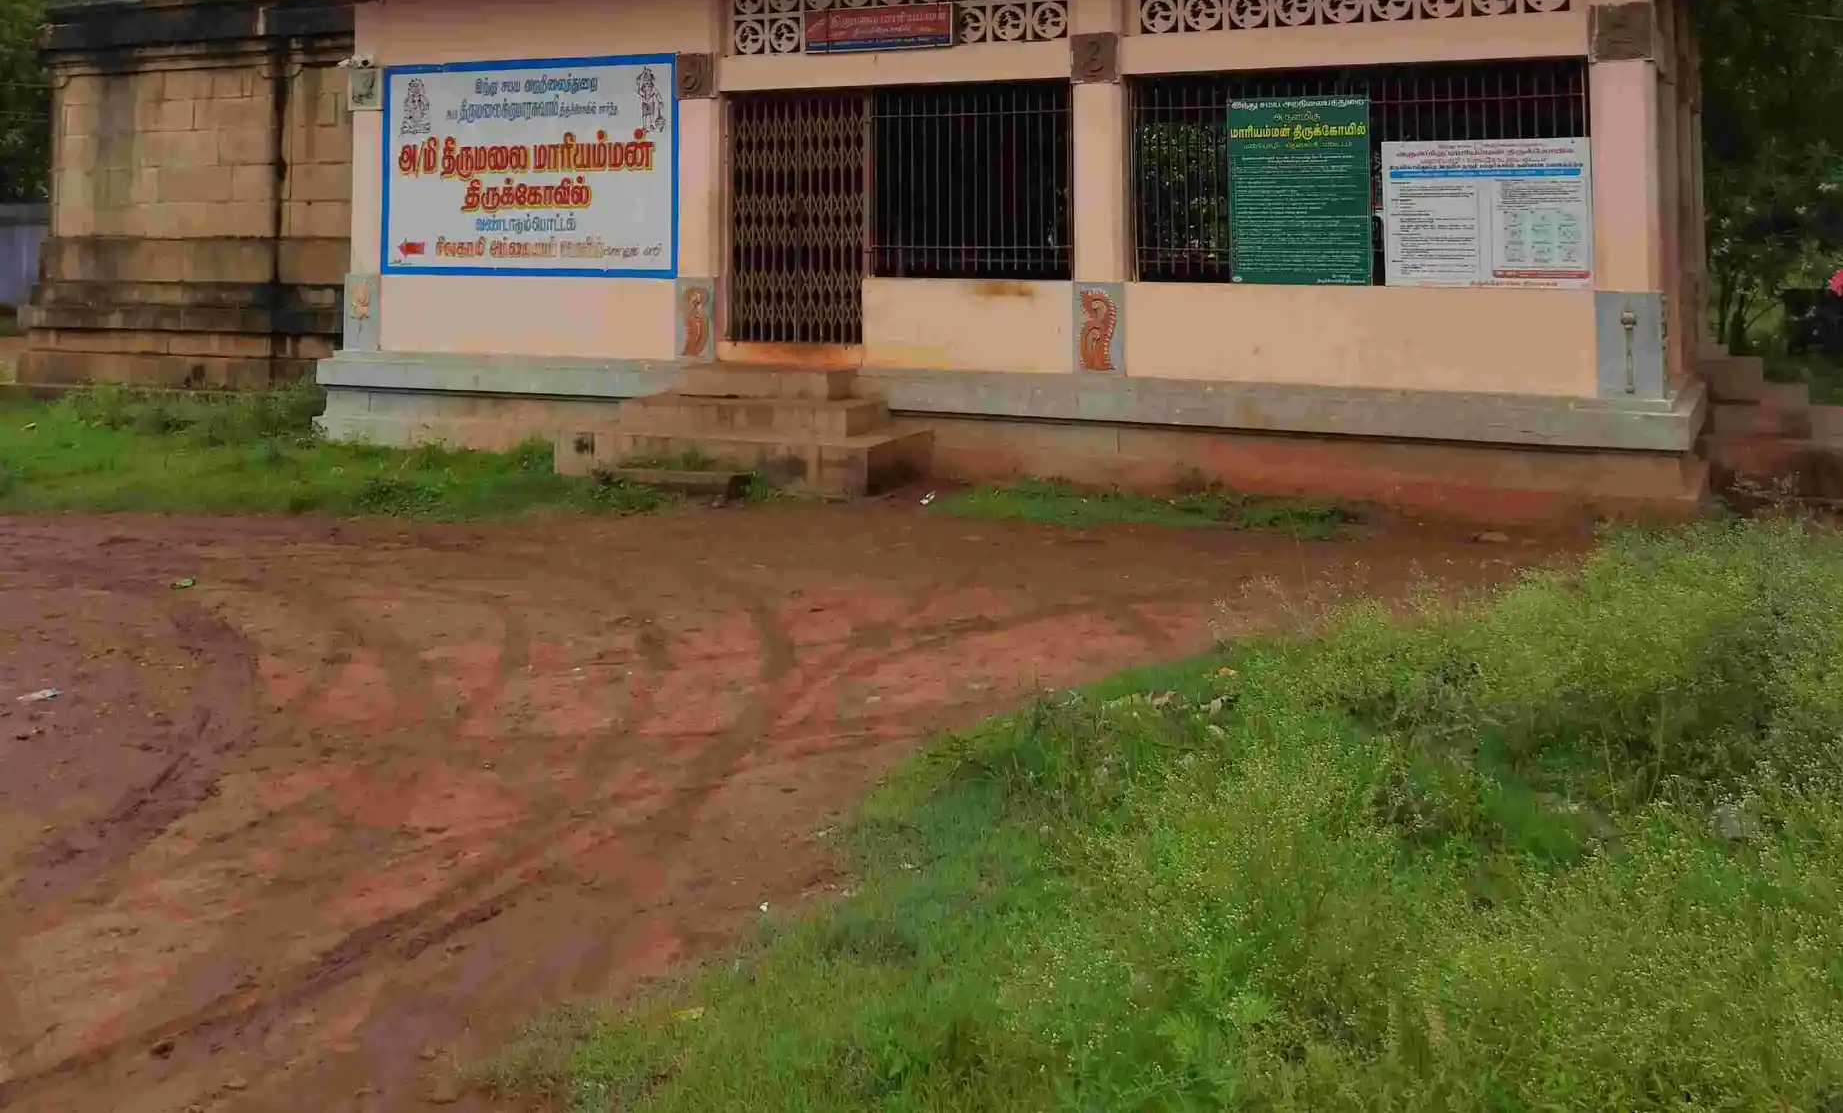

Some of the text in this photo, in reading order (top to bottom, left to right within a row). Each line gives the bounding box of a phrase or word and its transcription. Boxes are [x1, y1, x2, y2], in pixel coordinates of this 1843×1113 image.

[475, 78, 498, 96] இந்து
[501, 80, 521, 94] சமய
[1230, 122, 1366, 140] மாரியம்மன் திருக்கோயில்
[440, 136, 530, 181] திருமலை
[534, 128, 656, 173] மாரியம்மன்
[461, 176, 592, 213] திருக்கோவில்
